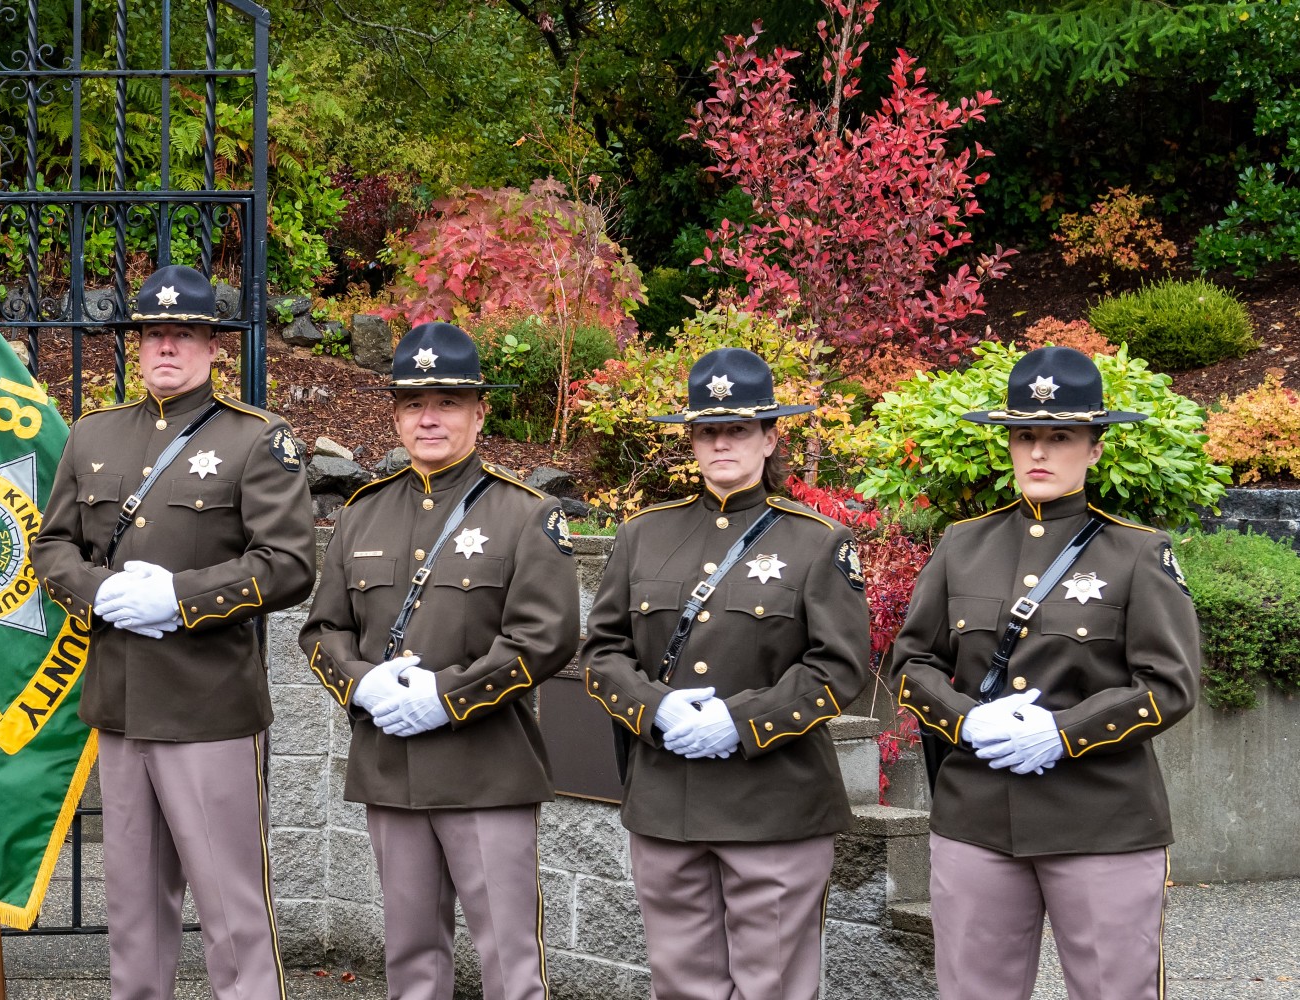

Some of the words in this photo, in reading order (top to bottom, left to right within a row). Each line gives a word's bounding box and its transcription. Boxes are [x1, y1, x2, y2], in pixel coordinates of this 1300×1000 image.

[273, 431, 282, 449] KING
[547, 511, 558, 530] KING
[0, 529, 13, 571] STATE
[838, 543, 849, 562] KING
